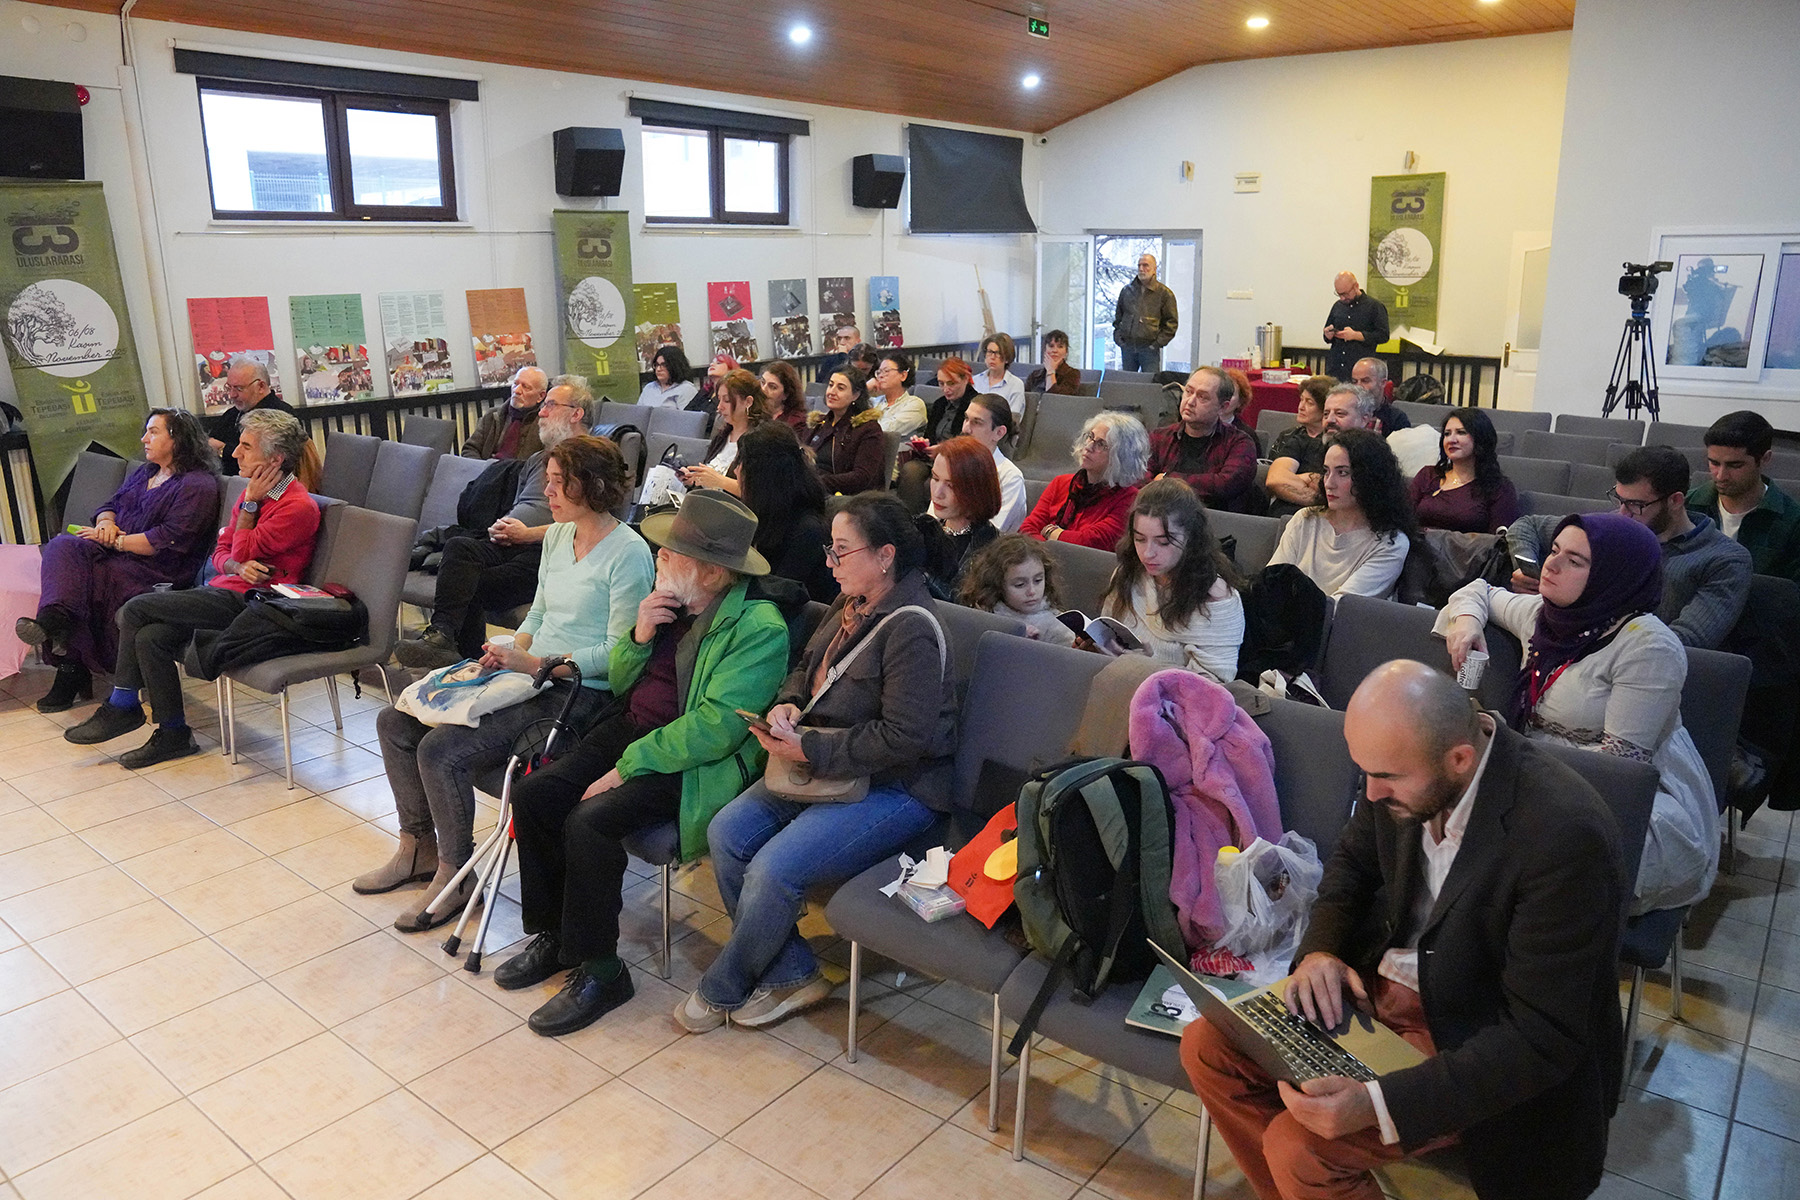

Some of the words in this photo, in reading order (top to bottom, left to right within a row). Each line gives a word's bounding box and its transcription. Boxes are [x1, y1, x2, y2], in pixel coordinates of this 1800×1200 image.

[16, 254, 84, 268] ULUSLARARASI
[46, 348, 102, 363] November
[1459, 665, 1467, 686] coffee
